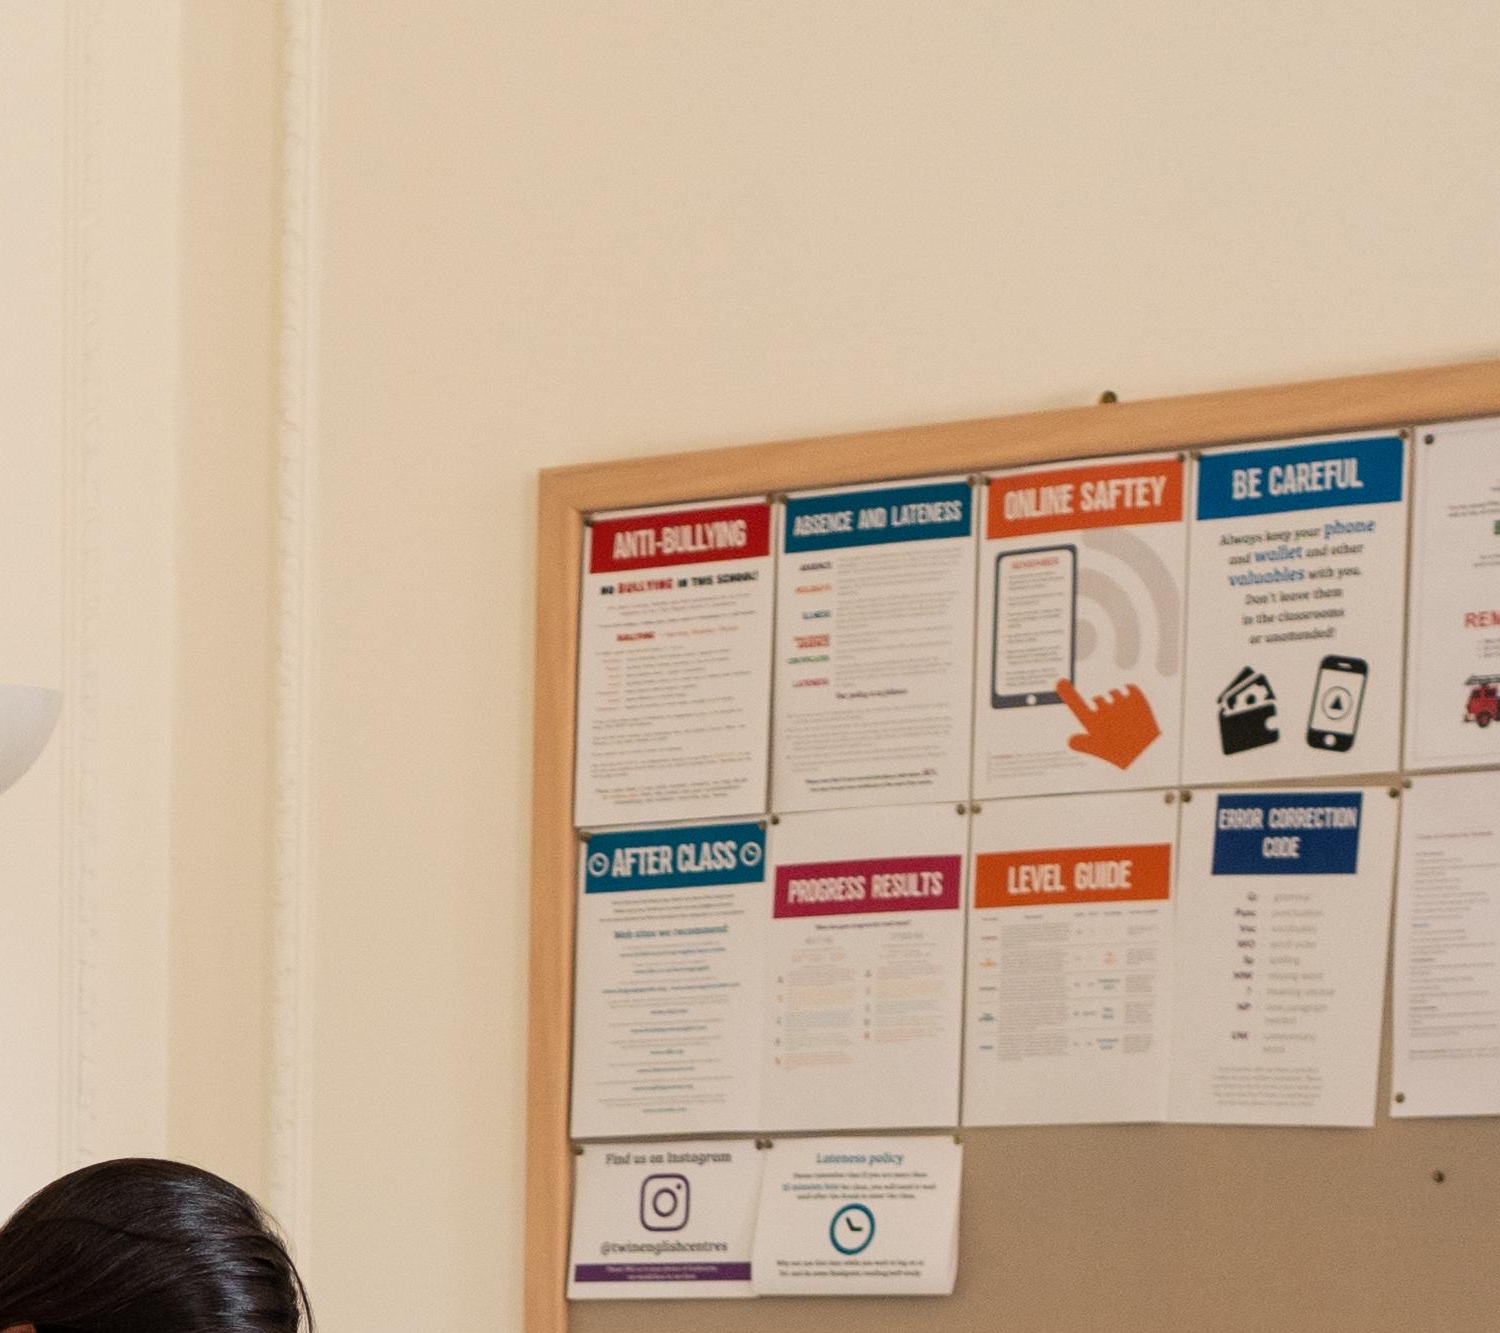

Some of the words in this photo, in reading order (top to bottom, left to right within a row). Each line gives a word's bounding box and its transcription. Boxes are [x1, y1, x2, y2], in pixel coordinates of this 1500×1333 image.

[1231, 467, 1262, 500] BE
[1268, 457, 1365, 496] CAREFUL
[1003, 483, 1075, 521] ONLINE
[1079, 475, 1167, 512] SAFTEY
[793, 511, 853, 537] ABSENCE
[857, 507, 887, 529] AND
[890, 500, 963, 526] LATENESS
[1324, 519, 1376, 540] phone
[612, 519, 747, 560] ANTI-BULLYING
[1254, 545, 1303, 562] wallet
[1228, 567, 1305, 586] valuables
[1218, 807, 1264, 831] ERROR
[1268, 806, 1358, 830] CORRECTION
[610, 845, 674, 878] AFTER
[676, 840, 738, 873] CLASS
[1262, 836, 1302, 859] CODE
[787, 875, 867, 904] PROGRESS
[870, 871, 944, 899] RESULTS
[1006, 863, 1066, 895] LEVEL
[1073, 859, 1133, 891] GUIDE
[605, 1153, 631, 1164] Find
[666, 1151, 732, 1165] Instagram
[816, 1152, 866, 1164] Lateness
[868, 1152, 905, 1166] policy
